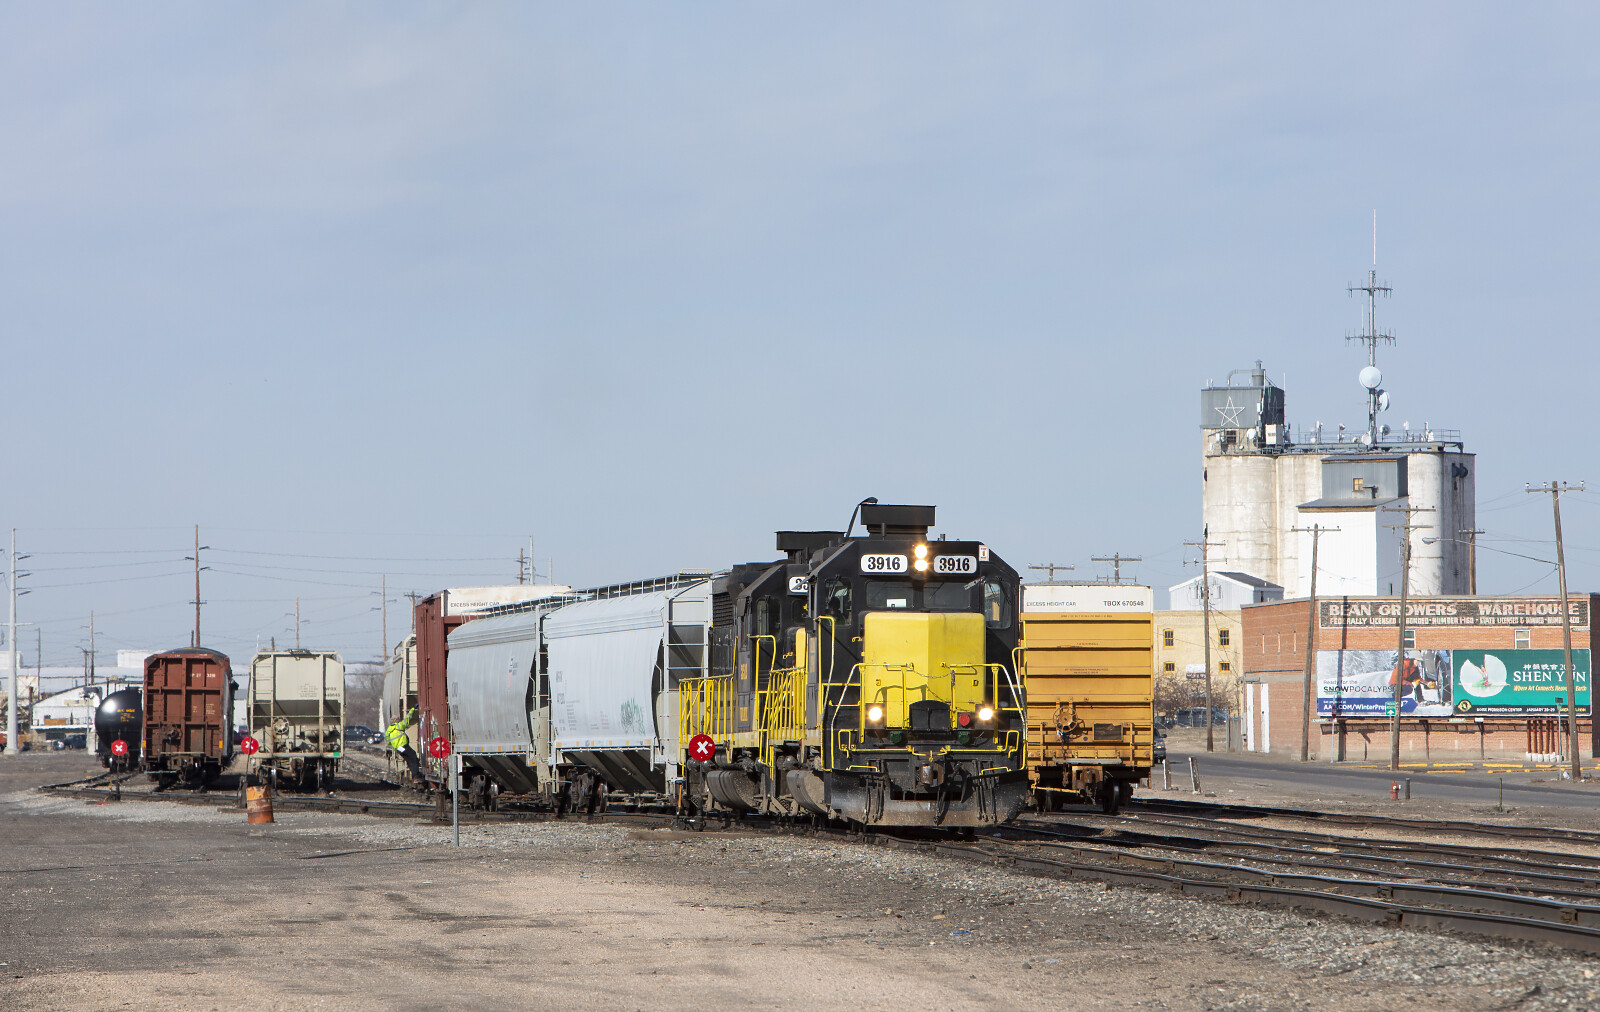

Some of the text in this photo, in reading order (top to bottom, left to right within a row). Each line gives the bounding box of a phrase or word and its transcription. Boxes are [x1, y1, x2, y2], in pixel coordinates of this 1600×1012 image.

[867, 556, 901, 570] 3916
[939, 557, 970, 572] 3916
[1329, 603, 1372, 616] BEAN
[1378, 604, 1458, 616] GROWERS
[1513, 671, 1552, 682] SHEN
